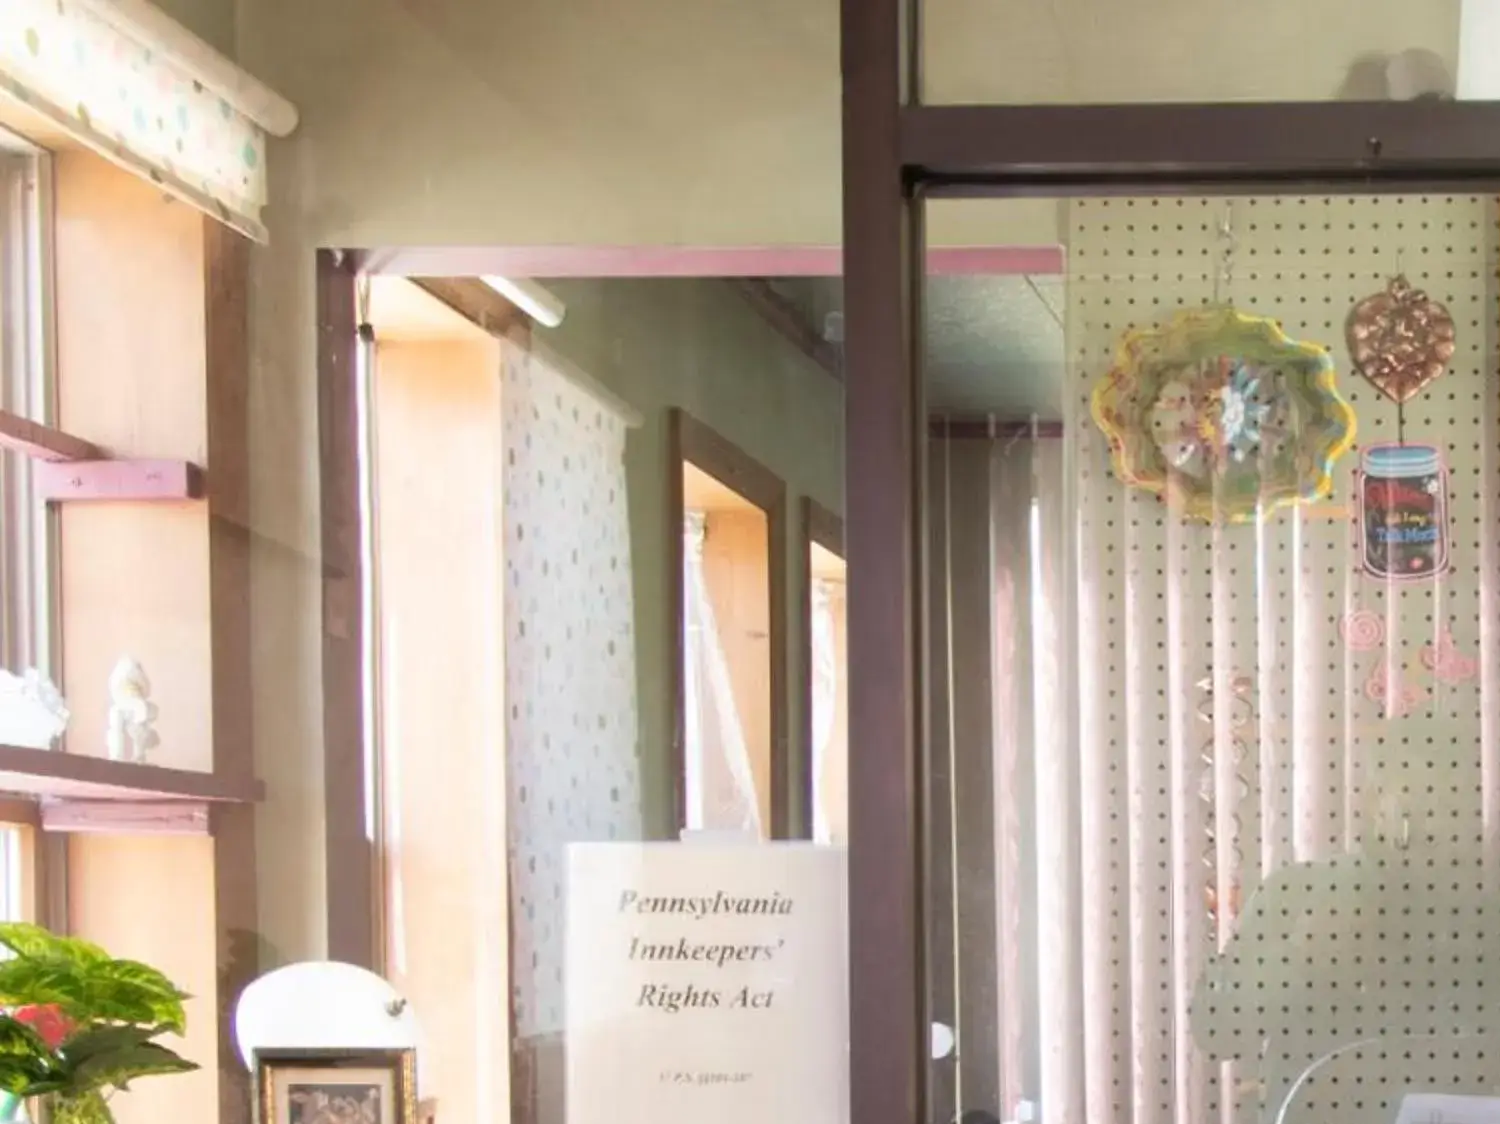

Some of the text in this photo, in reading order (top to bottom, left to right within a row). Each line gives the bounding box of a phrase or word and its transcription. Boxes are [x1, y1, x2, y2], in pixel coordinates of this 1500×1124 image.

[618, 890, 794, 920] Pennsylvania
[627, 937, 785, 967] Innkeepers'
[635, 985, 774, 1013] Rights Act
